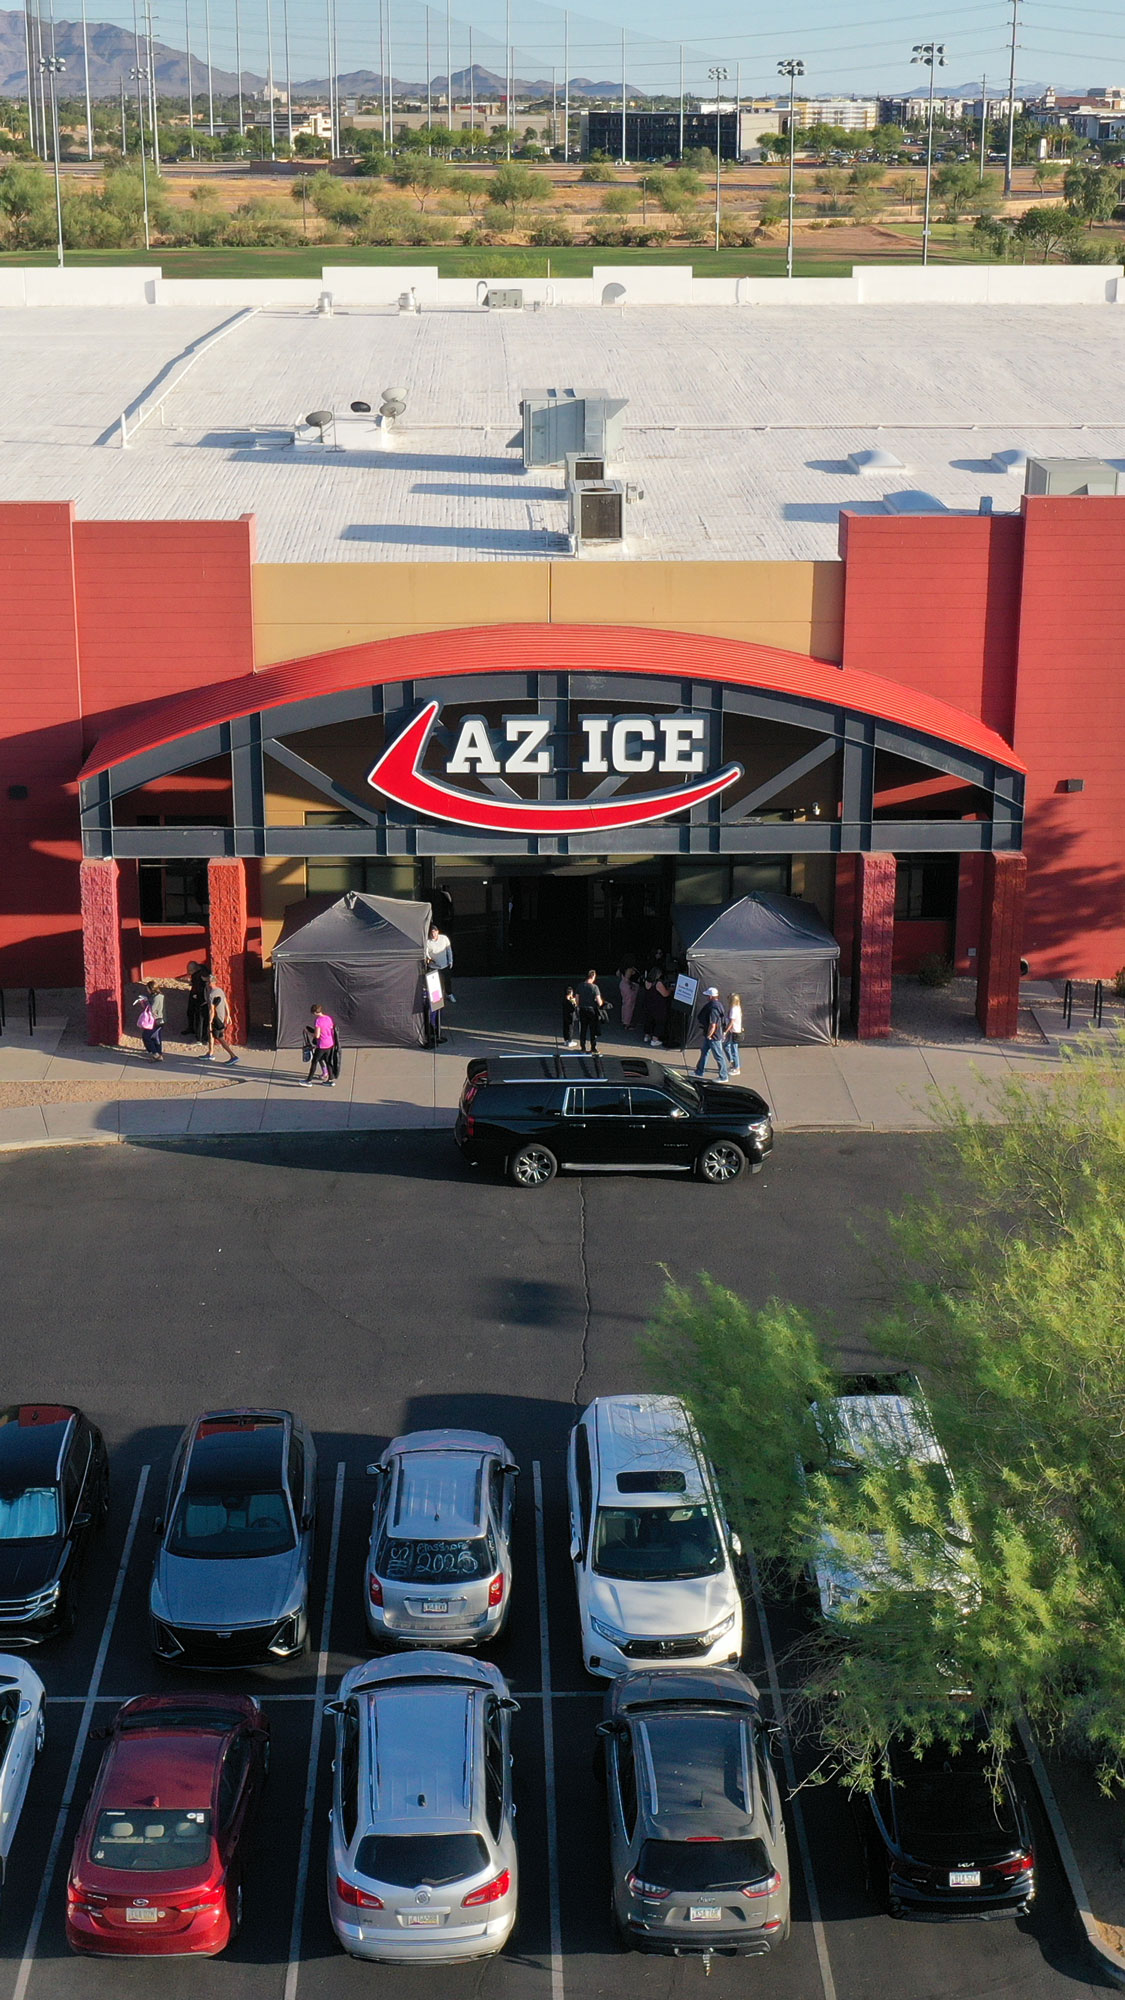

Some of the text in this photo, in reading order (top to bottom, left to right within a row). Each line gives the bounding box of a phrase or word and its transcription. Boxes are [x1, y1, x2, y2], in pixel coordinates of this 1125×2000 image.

[446, 719, 705, 774] AZ ICE
[415, 1551, 479, 1574] 2025
